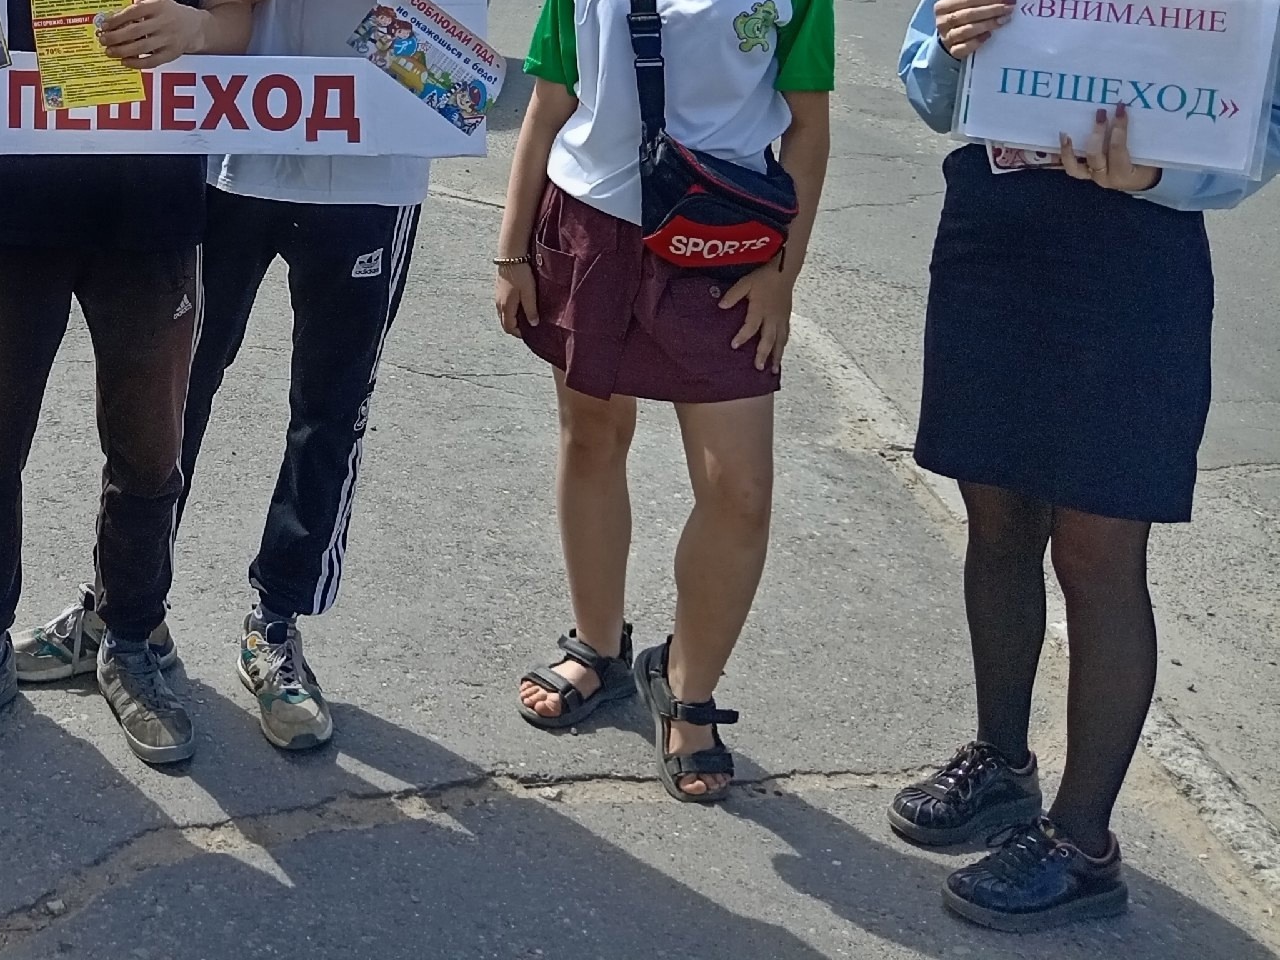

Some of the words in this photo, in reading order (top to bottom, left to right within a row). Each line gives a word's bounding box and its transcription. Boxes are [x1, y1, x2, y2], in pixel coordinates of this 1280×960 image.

[395, 5, 409, 19] не
[410, 16, 463, 58] окажешься
[463, 57, 471, 65] в
[471, 43, 497, 67] ПДД
[997, 66, 1240, 124] ПЕШЕХОД»
[669, 235, 770, 259] SPORTS
